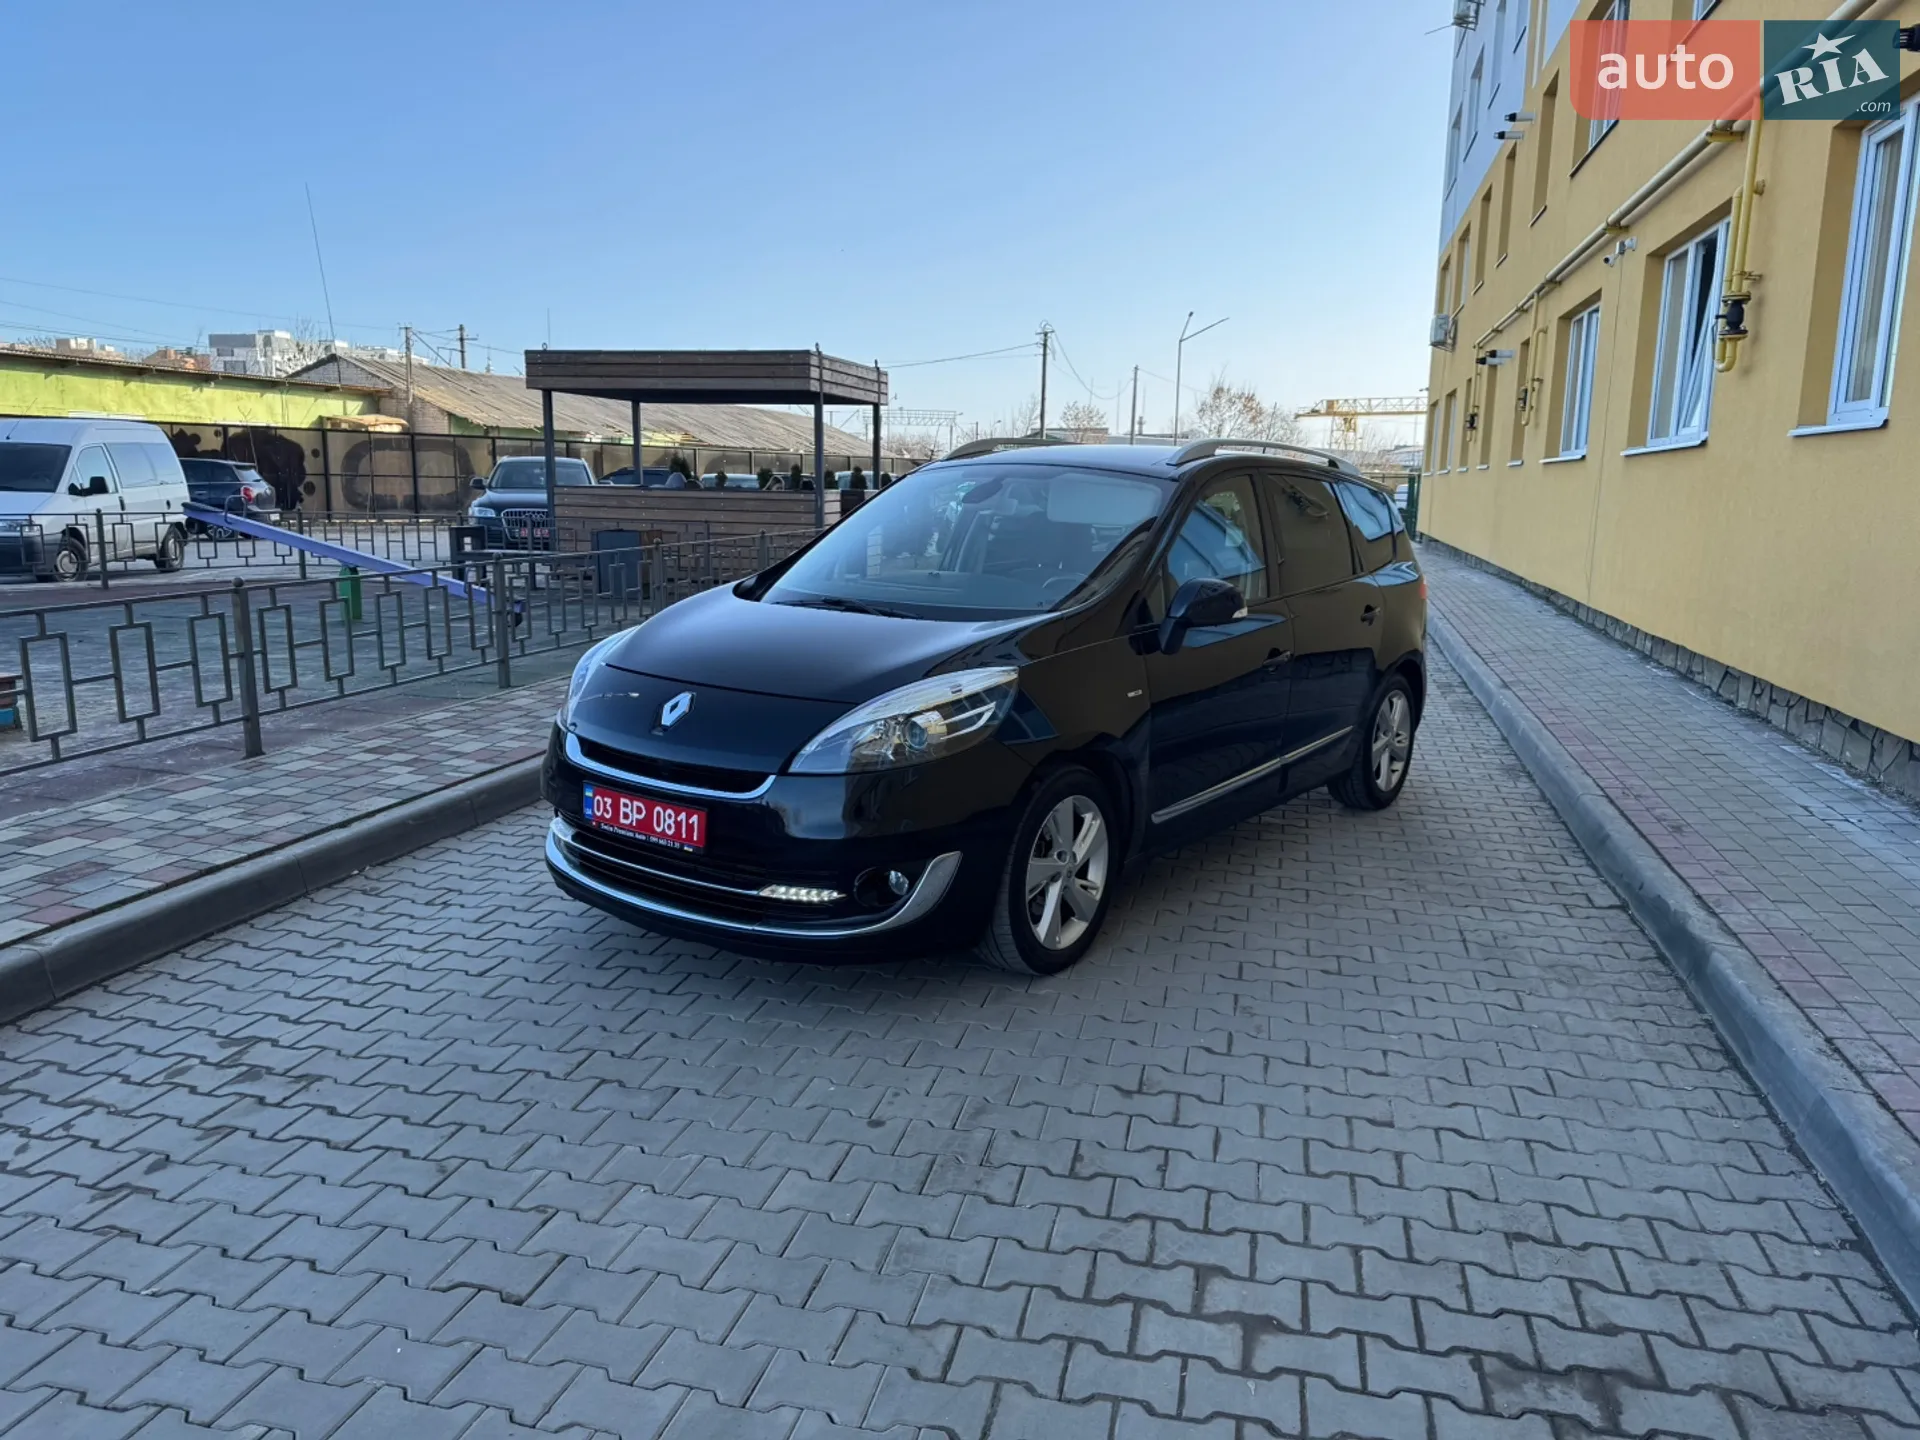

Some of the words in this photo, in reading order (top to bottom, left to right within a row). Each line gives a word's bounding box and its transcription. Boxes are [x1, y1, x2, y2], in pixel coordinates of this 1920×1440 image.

[593, 795, 612, 819] 03
[619, 797, 646, 826] BP
[653, 806, 699, 841] 0811
